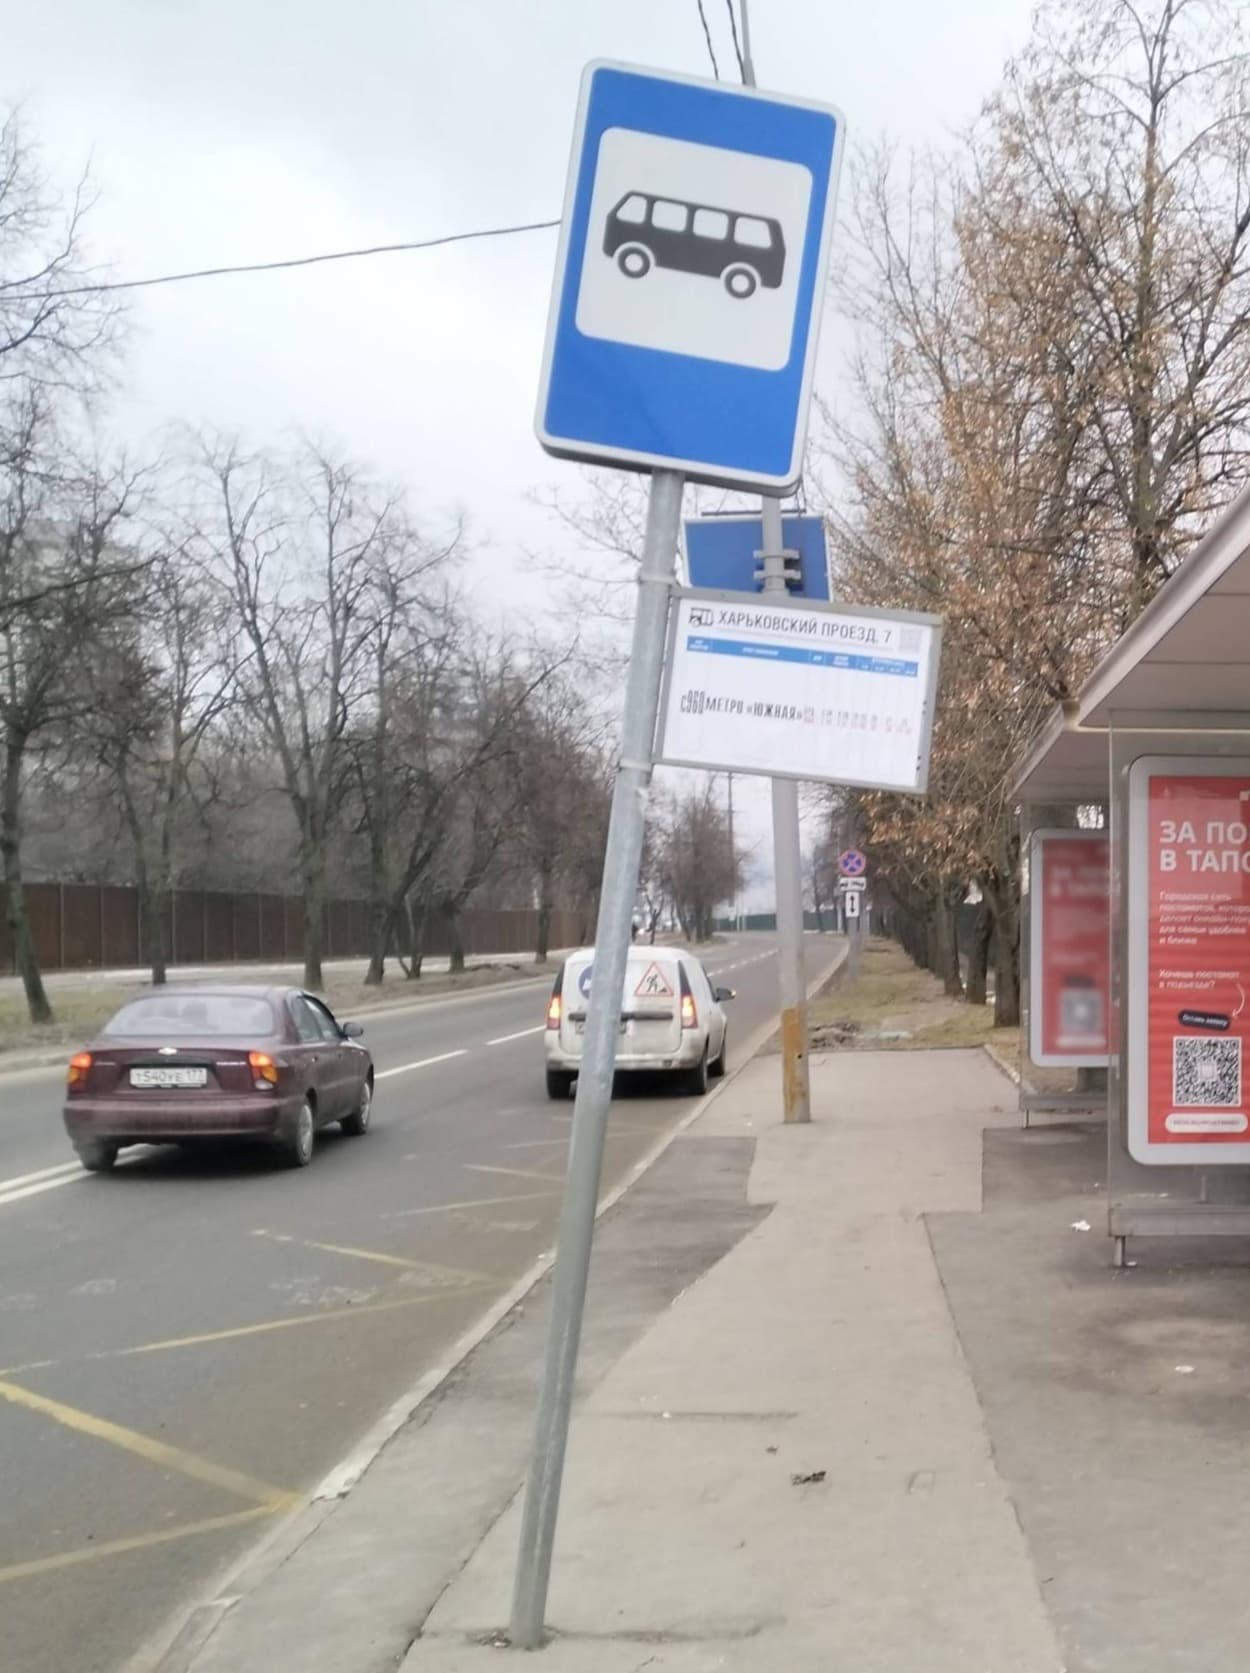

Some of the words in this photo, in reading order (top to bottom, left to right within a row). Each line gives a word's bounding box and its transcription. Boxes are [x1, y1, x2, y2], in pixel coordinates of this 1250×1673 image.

[718, 609, 818, 634] ХАРЬКОВСКИЙ
[883, 630, 893, 644] 7
[705, 695, 744, 714] МЕТРО
[746, 700, 803, 721] «ЮЖНАЯ»
[1159, 820, 1196, 845] ЗА
[1159, 849, 1177, 872] В
